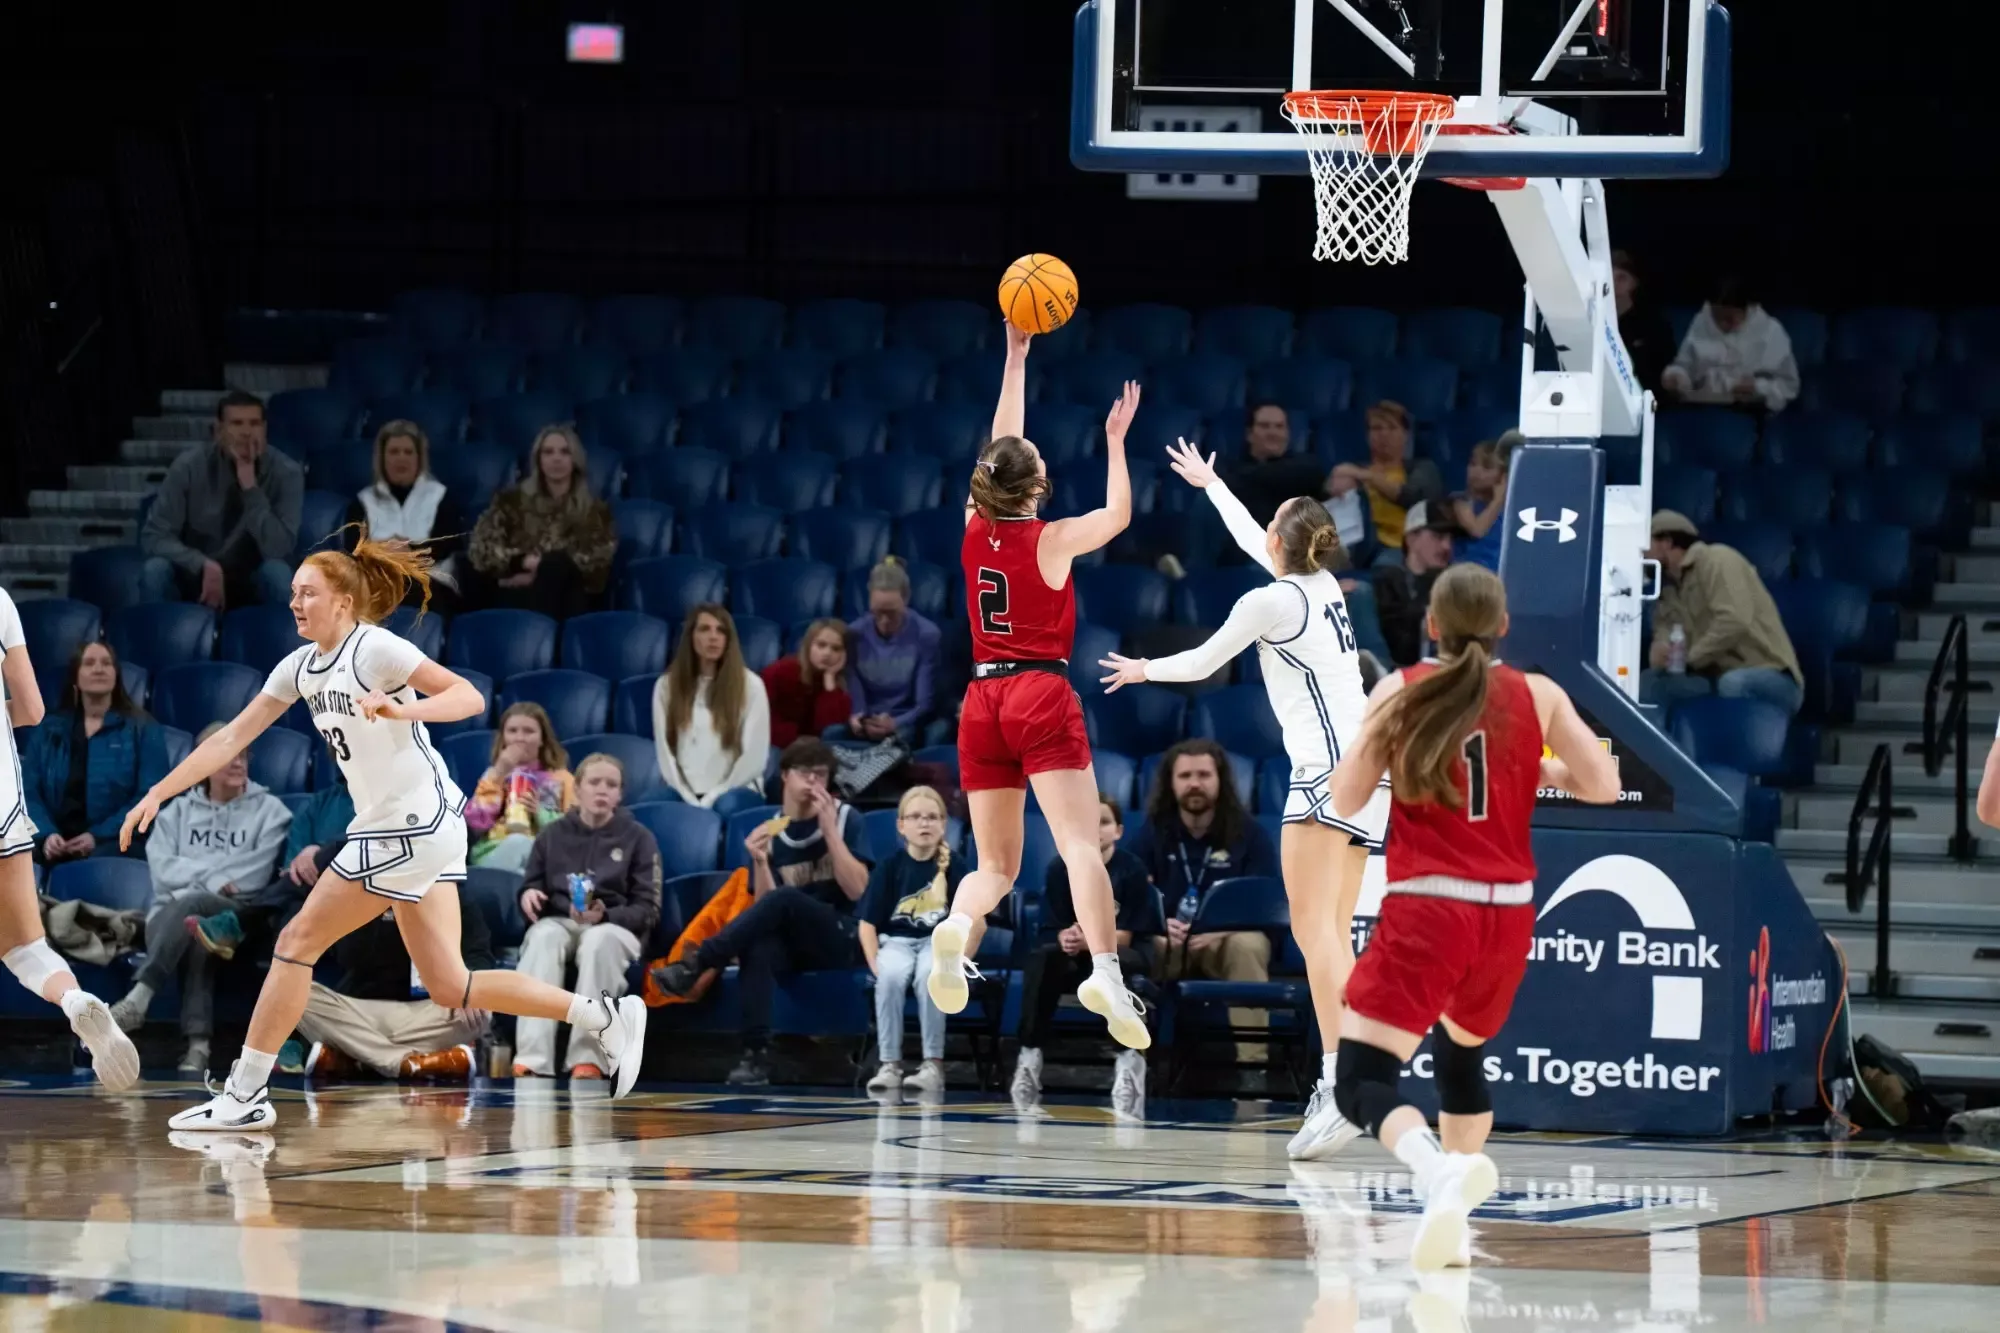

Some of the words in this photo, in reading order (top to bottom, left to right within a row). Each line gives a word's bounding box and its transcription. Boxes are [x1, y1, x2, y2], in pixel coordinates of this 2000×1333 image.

[978, 566, 1013, 635] 2
[1324, 601, 1355, 653] 15
[328, 690, 356, 717] STATE
[1461, 729, 1488, 823] 1
[189, 829, 246, 850] MSU
[1618, 931, 1721, 969] Bank
[1772, 970, 1825, 1007] Intermountain
[1771, 1014, 1796, 1051] Health
[1517, 1047, 1720, 1097] Together
